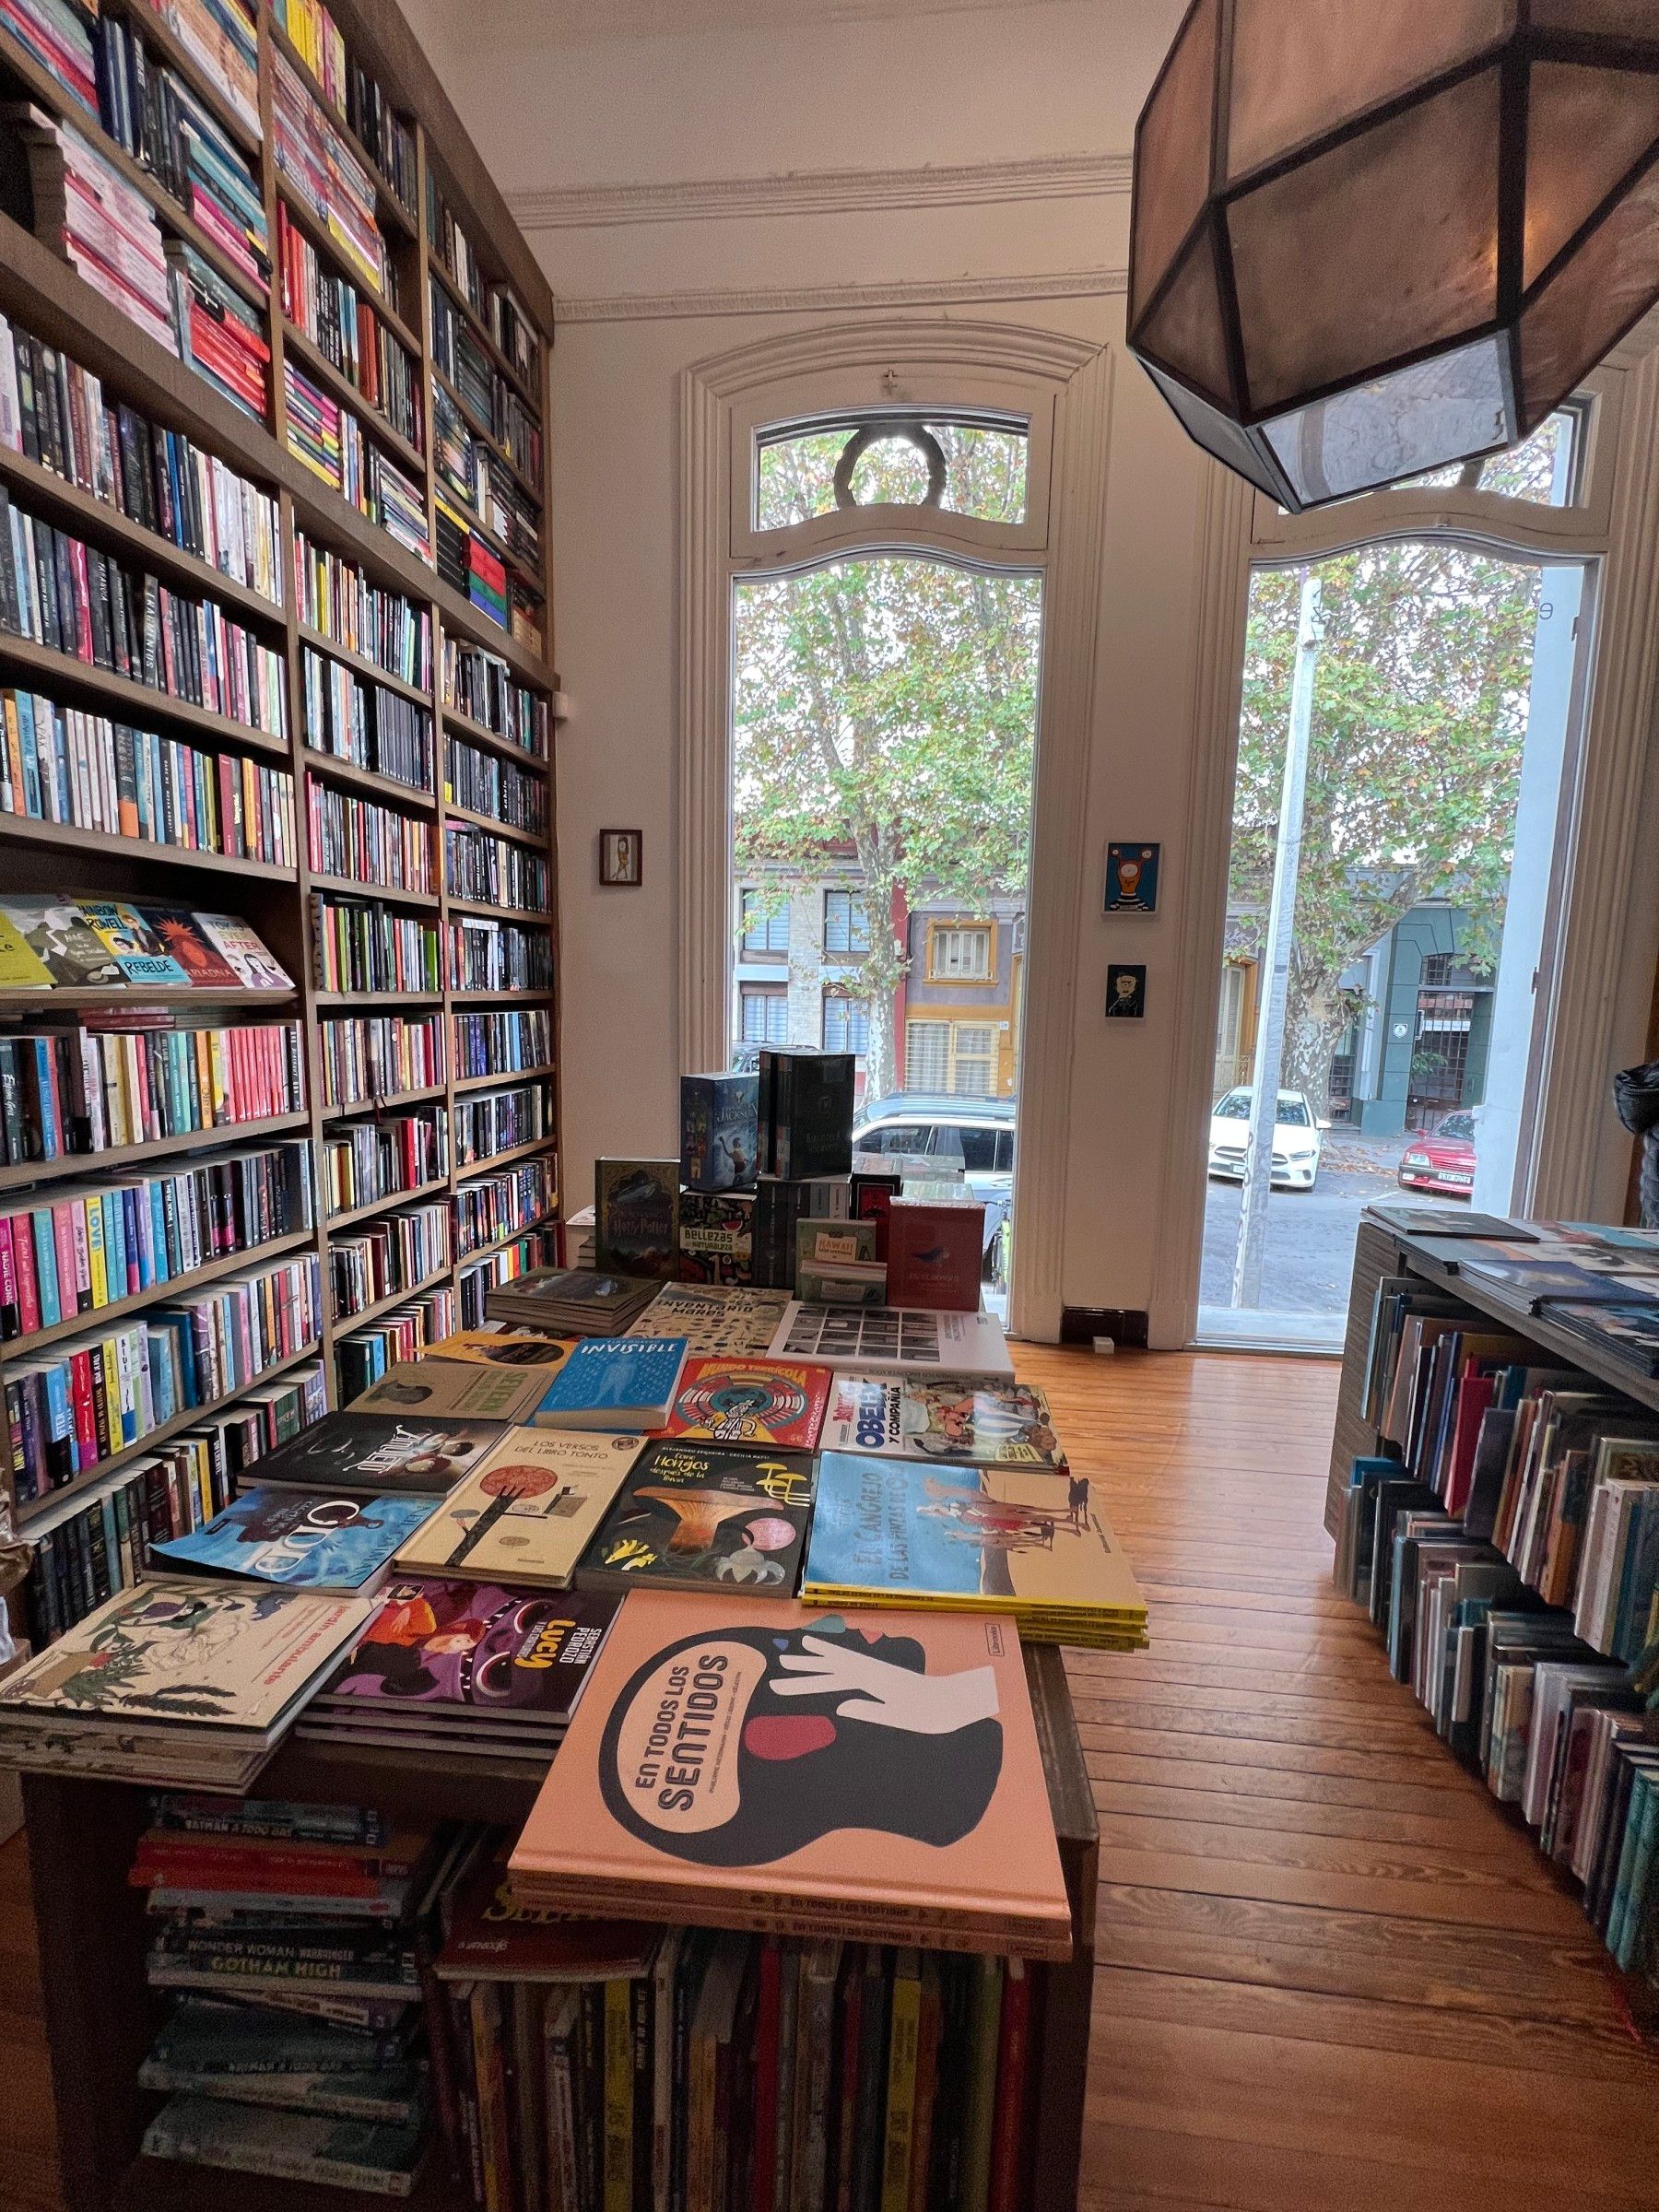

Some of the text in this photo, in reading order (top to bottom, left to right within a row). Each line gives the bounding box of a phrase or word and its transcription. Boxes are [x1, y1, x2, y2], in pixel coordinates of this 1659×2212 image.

[145, 592, 158, 669] FRAGMENTOS
[224, 939, 263, 951] AFTER
[124, 959, 173, 979] REBELDE
[90, 1207, 102, 1248] LOVE
[2, 1251, 11, 1279] NADIE
[581, 1342, 677, 1355] INVISIBLE
[699, 1362, 746, 1378] MUNDO
[888, 1386, 901, 1435] COMPAÑÍA
[514, 1446, 608, 1460] DEL LIBRO TONTO
[533, 1440, 599, 1452] LOS VERSOS
[654, 1454, 711, 1473] Hongos
[853, 1473, 882, 1543] CANGREJO
[887, 1506, 908, 1540] PINZAS
[888, 1544, 908, 1562] LAS
[888, 1567, 909, 1581] DE
[264, 1631, 323, 1685] ambulante
[559, 1627, 591, 1664] PEDROZO
[574, 1628, 603, 1665] SEBASTIÁN
[635, 1665, 690, 1789] EN TODOS LOS
[657, 1654, 729, 1813] SENTIDOS
[188, 1939, 243, 1954] WONDER
[247, 1943, 294, 1958] WOMAN
[211, 1956, 342, 1978] GOTHAM HIGH
